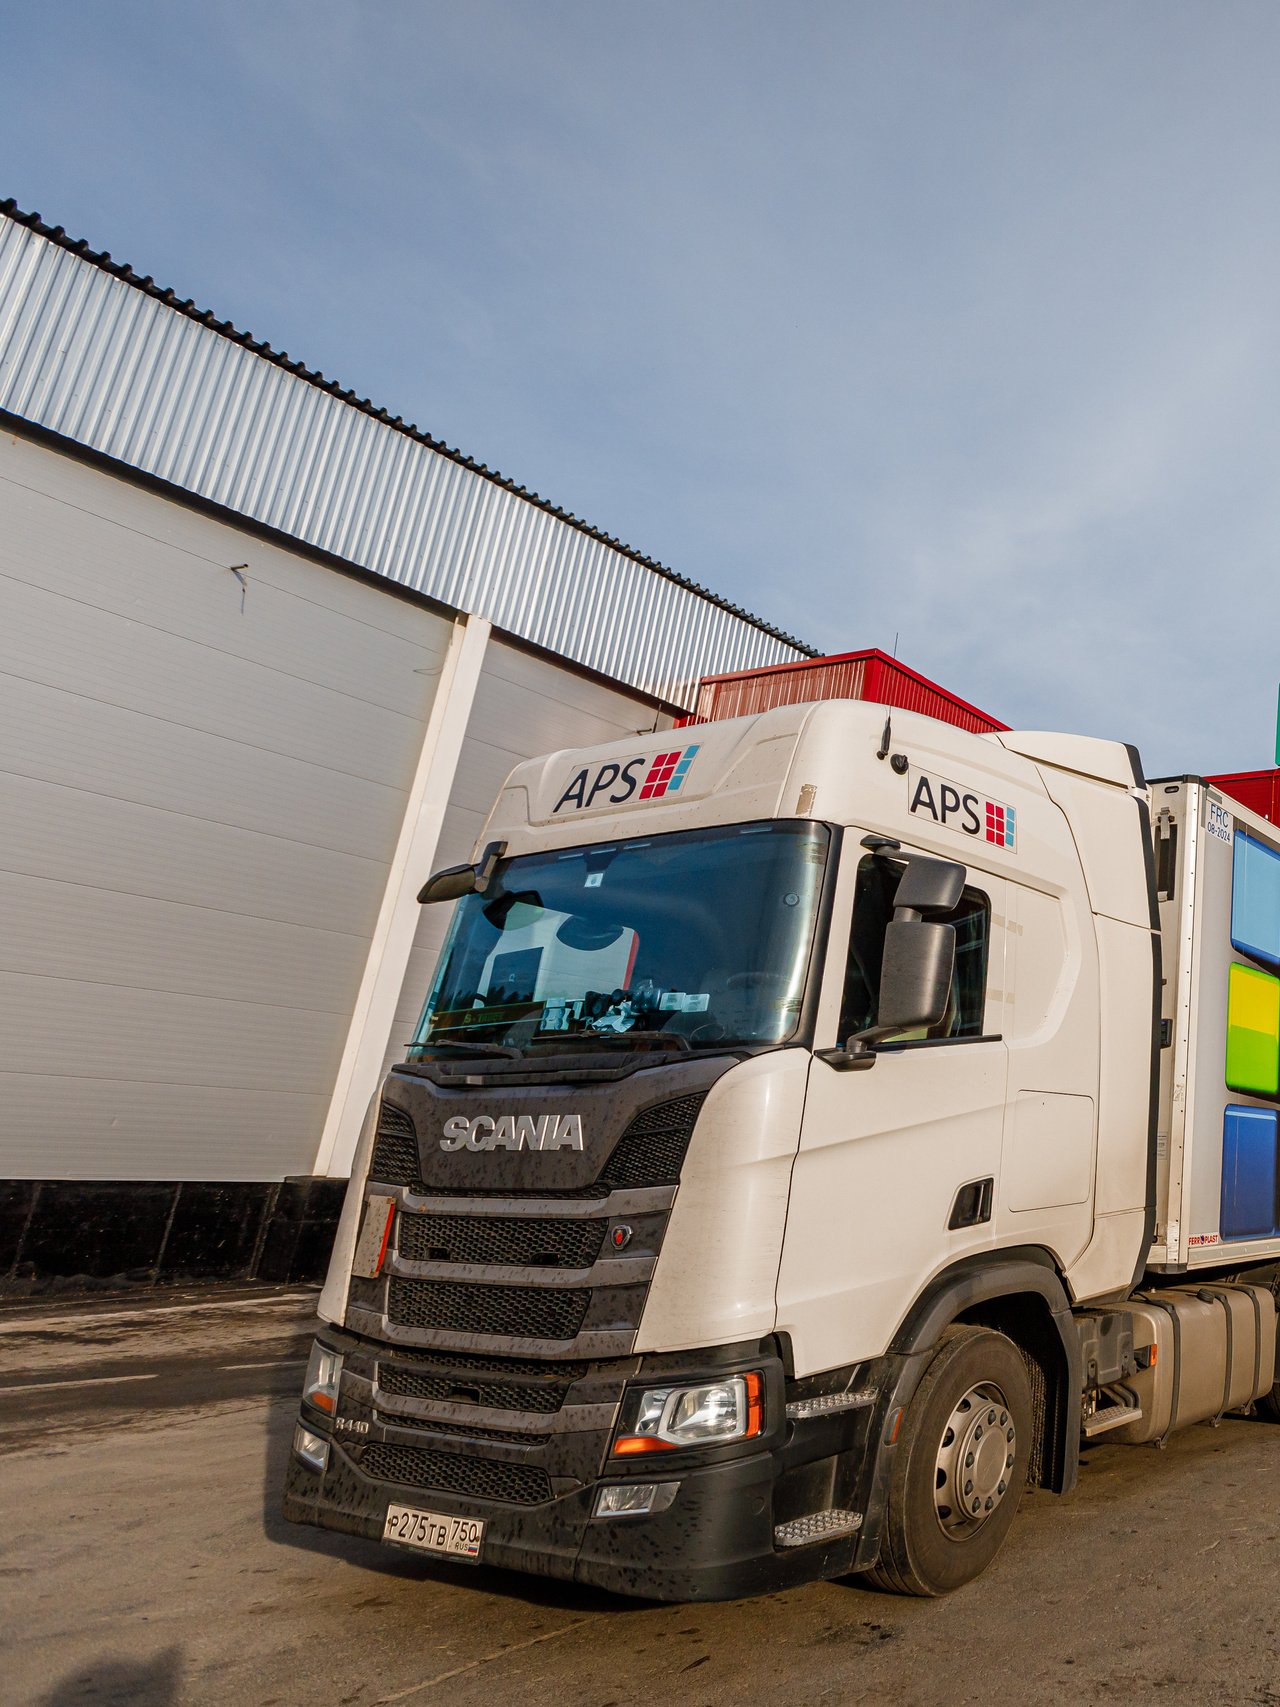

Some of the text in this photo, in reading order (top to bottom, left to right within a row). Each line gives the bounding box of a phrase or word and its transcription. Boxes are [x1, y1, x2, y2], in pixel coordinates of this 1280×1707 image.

[552, 758, 646, 813] APS
[910, 776, 981, 835] APS
[1210, 803, 1229, 828] FRC
[439, 1114, 584, 1152] SCANIA
[451, 1520, 478, 1543] 750
[454, 1541, 469, 1551] RUS
